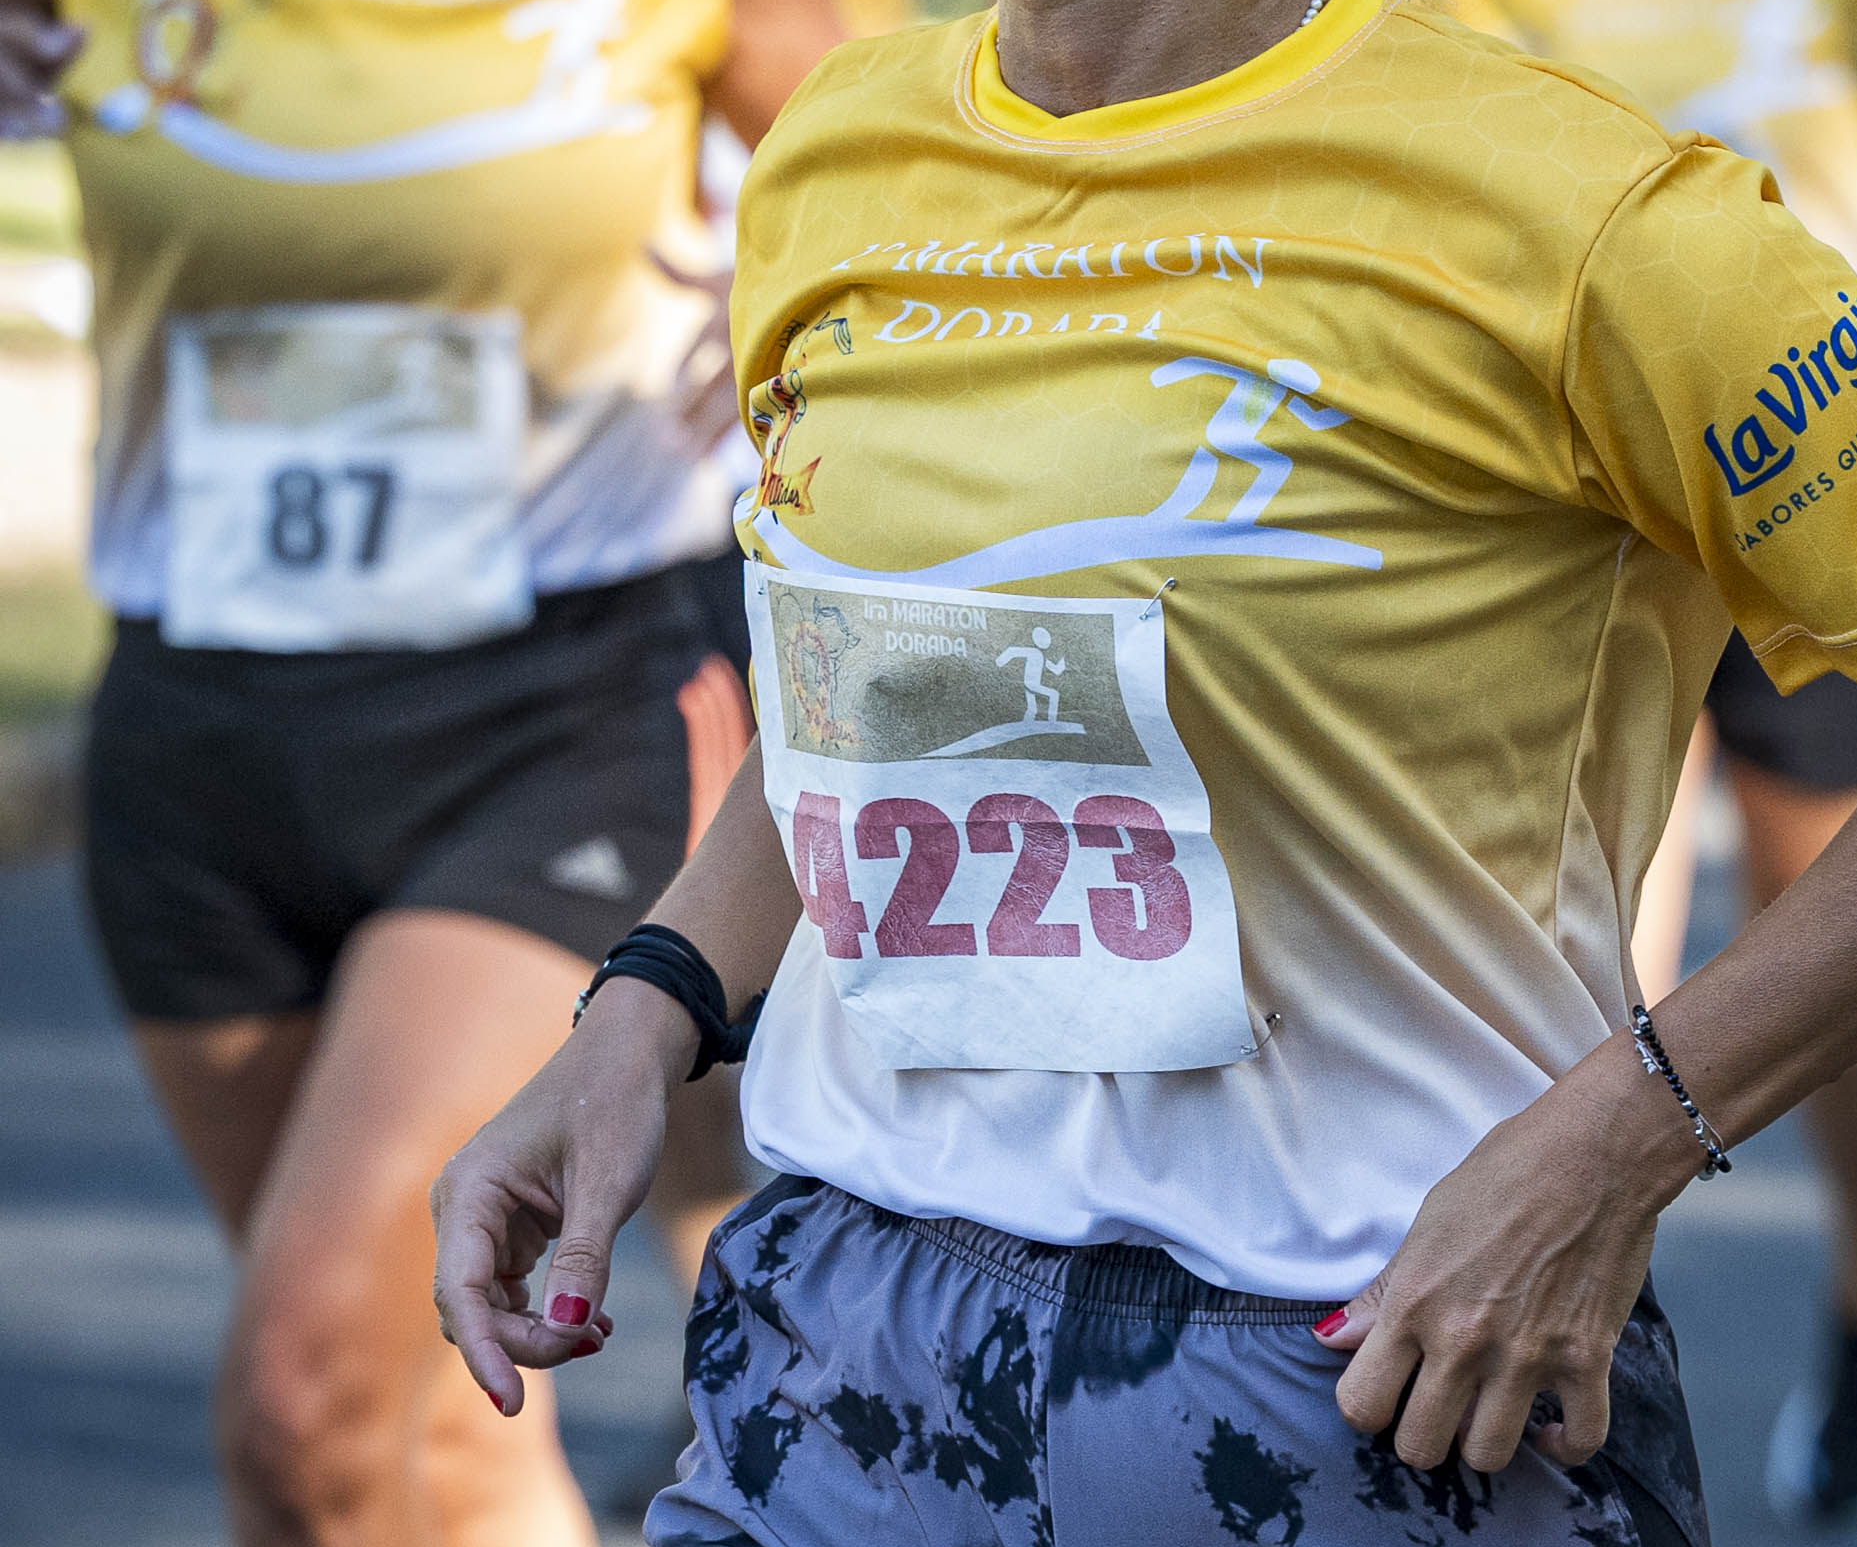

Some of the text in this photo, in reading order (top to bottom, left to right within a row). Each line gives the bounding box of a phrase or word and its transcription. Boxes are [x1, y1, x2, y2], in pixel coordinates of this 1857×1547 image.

[268, 465, 396, 570] 87
[884, 630, 968, 658] DORADA
[892, 600, 988, 630] MARATON
[793, 790, 1193, 961] 4223
